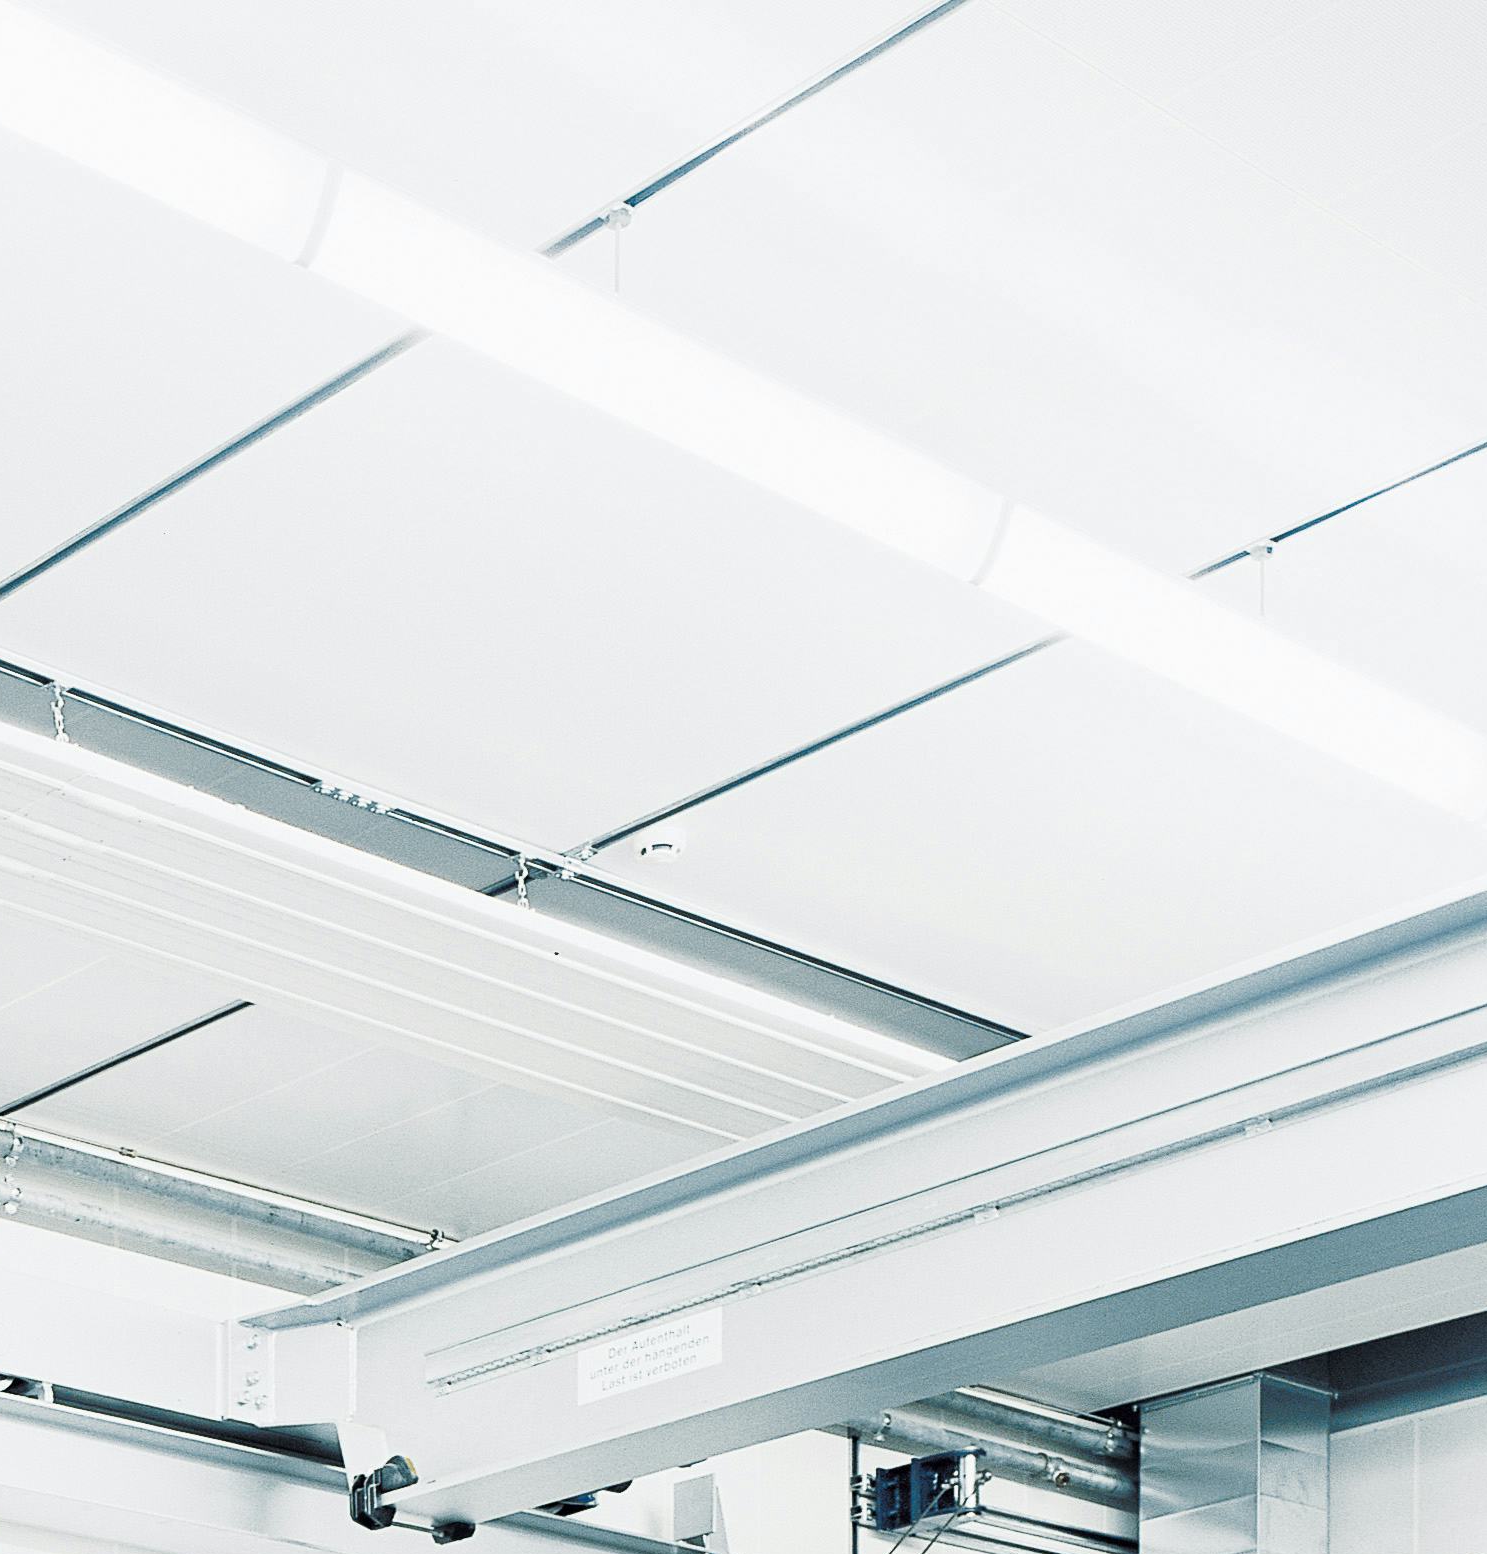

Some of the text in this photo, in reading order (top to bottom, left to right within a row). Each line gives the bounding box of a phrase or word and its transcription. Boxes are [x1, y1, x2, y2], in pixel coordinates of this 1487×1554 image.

[608, 1324, 691, 1359] Der Aufenthalt
[601, 1353, 698, 1391] Last ist verboten
[622, 1356, 642, 1370] der
